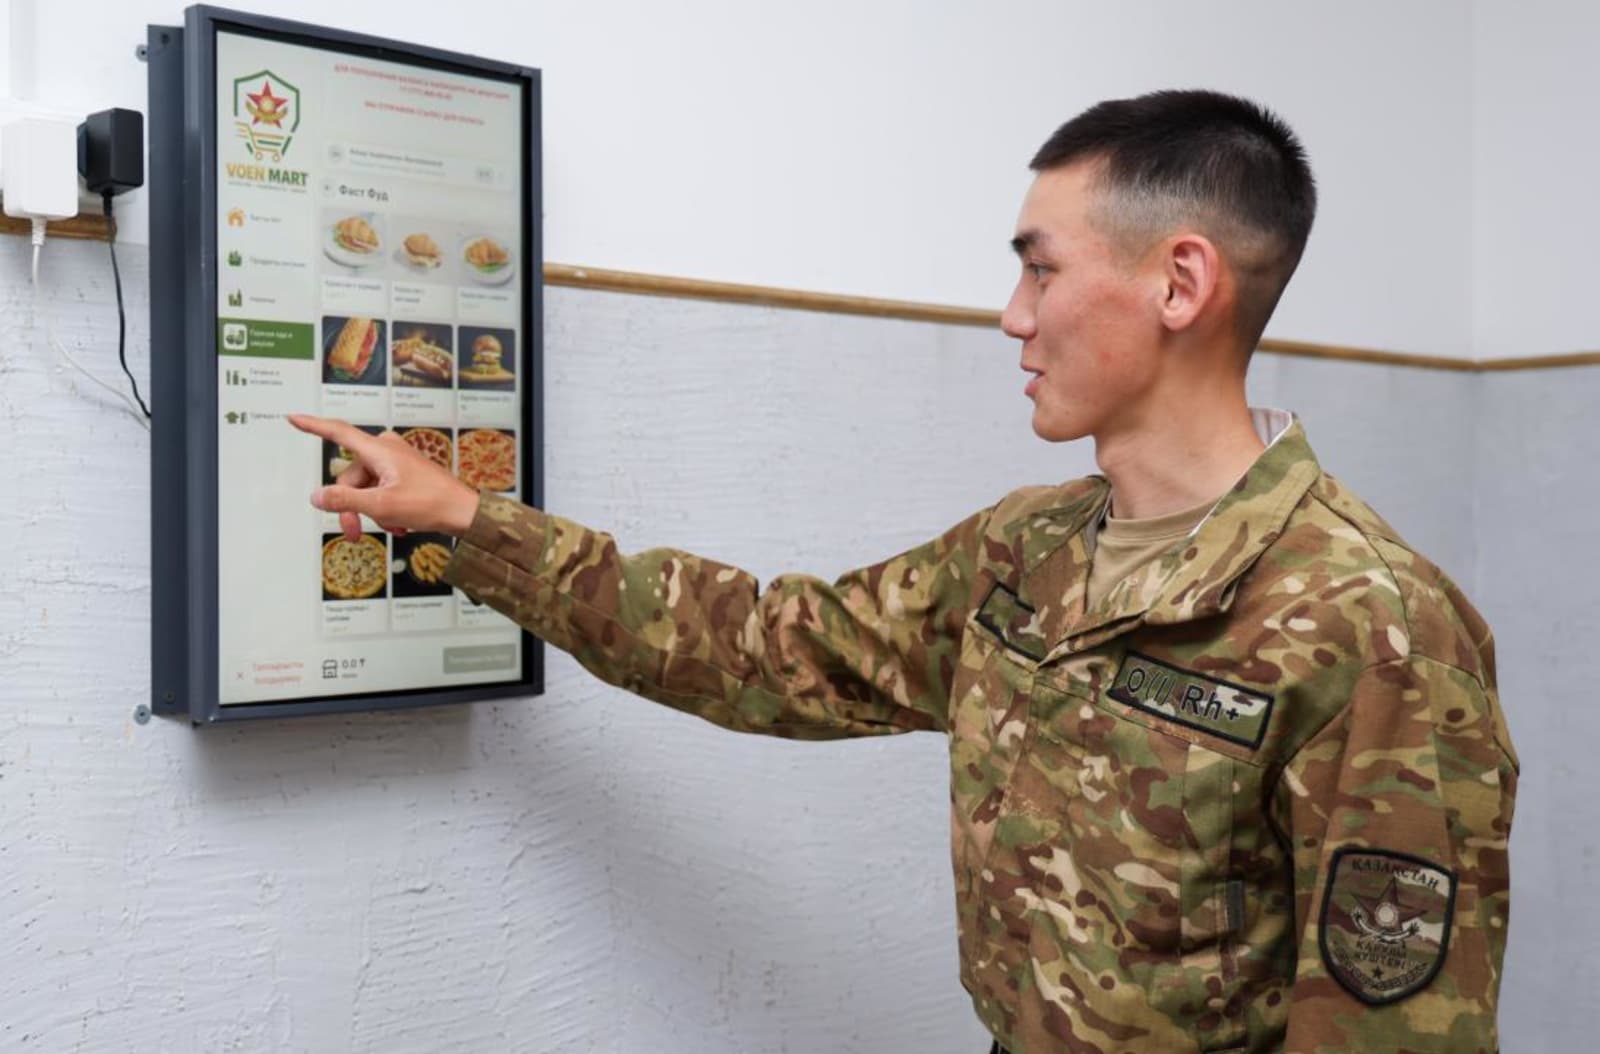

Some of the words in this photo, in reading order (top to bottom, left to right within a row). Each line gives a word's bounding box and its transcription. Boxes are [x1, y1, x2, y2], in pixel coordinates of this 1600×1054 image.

[225, 162, 265, 182] VOEN
[268, 167, 309, 187] MART
[338, 184, 366, 198] Фаст
[1181, 684, 1240, 722] Rh+
